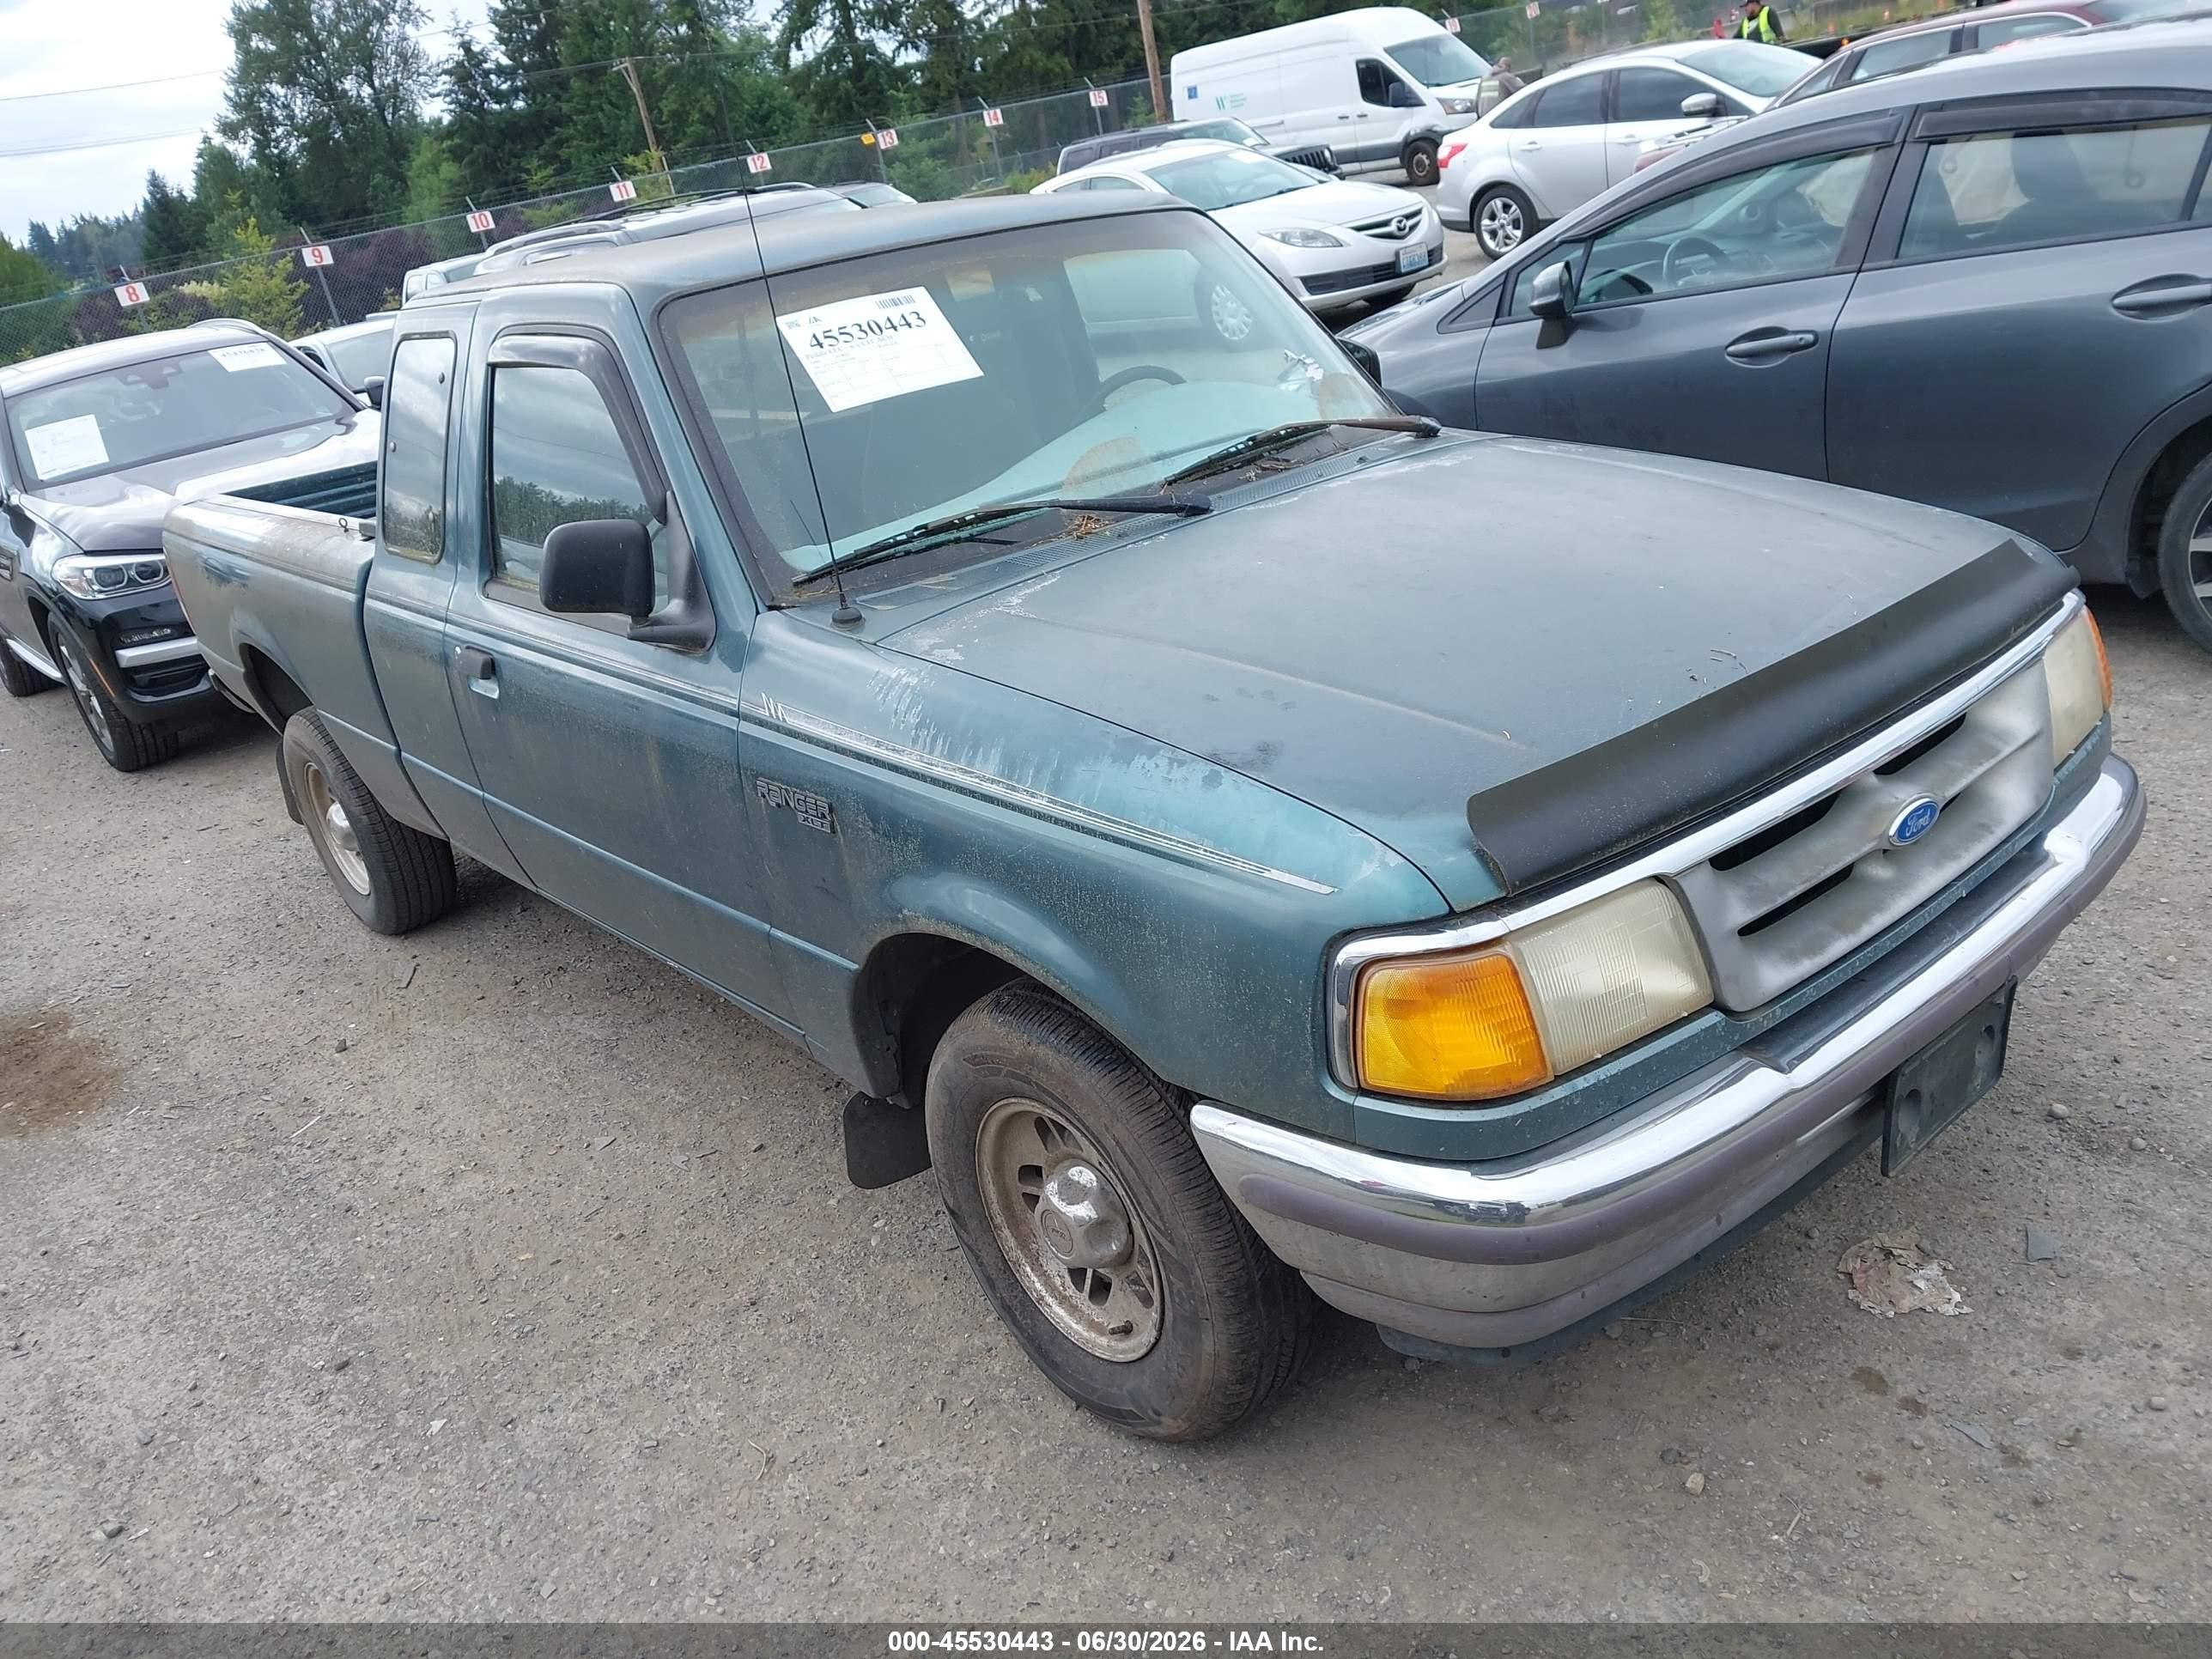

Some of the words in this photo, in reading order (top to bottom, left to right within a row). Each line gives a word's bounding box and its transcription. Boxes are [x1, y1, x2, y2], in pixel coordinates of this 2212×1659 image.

[1093, 91, 1105, 105] 15
[988, 110, 1000, 125] 14
[881, 131, 895, 146] 13
[751, 155, 768, 171] 12
[617, 183, 630, 198] 11
[471, 212, 489, 229] 10
[312, 246, 325, 264] 9
[125, 285, 139, 303] 8
[810, 311, 927, 349] 45530443
[756, 781, 831, 821] RANGER
[800, 815, 830, 832] XLT
[1905, 808, 1931, 837] Ford
